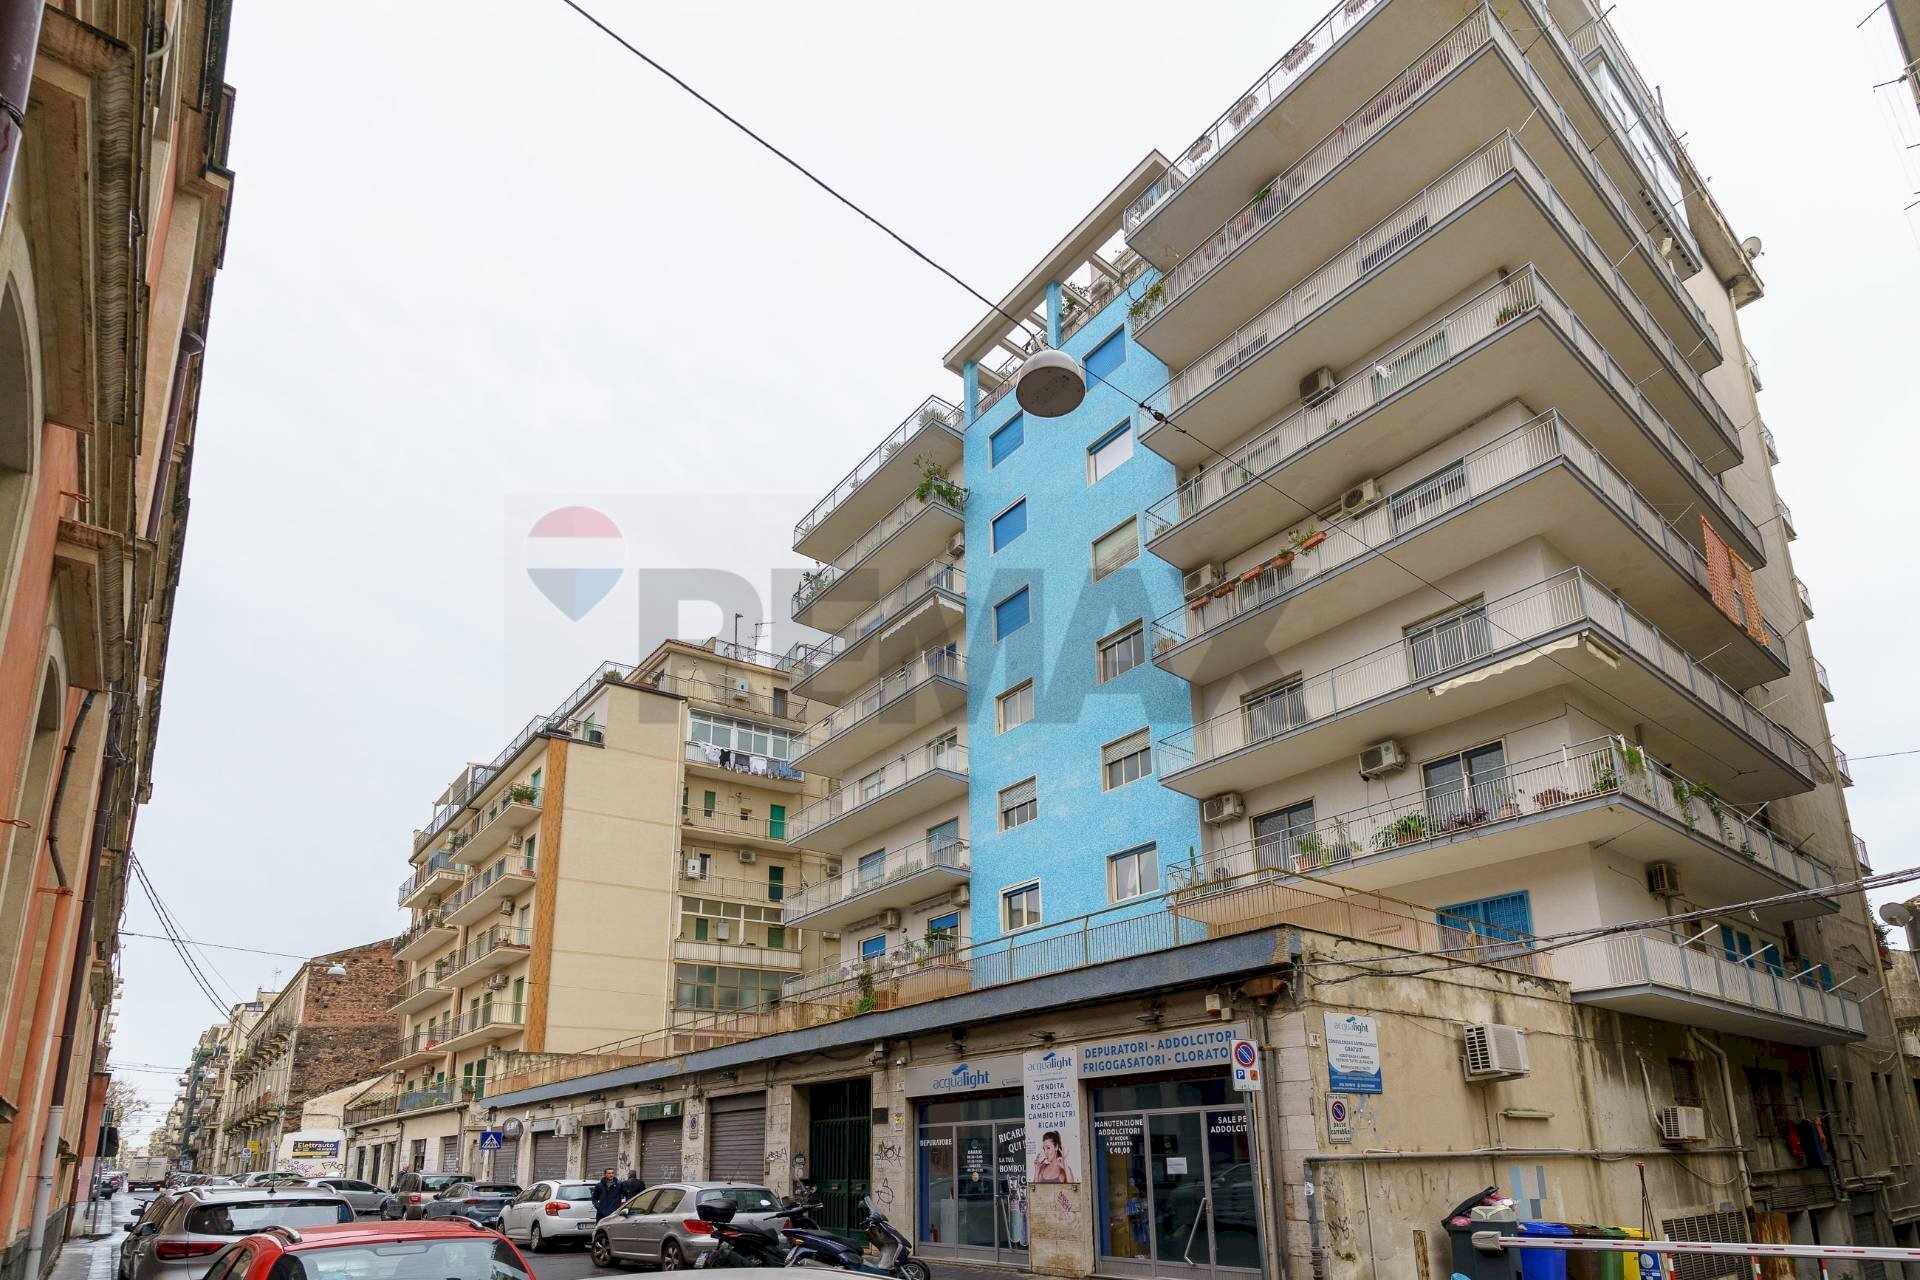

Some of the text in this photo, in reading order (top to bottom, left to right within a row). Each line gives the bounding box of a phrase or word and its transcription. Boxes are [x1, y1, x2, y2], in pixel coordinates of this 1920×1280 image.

[1084, 1041, 1148, 1059] DEPURATORI
[1157, 1029, 1236, 1051] ADDOLCITORI
[1027, 1056, 1072, 1072] acqualight
[1083, 1054, 1165, 1073] FRIGOGASATORI
[1174, 1047, 1230, 1064] CLORATO
[932, 1069, 991, 1091] acqualight
[1036, 1082, 1065, 1091] VENDITA
[1031, 1091, 1071, 1101] ASSISTENZA
[1030, 1102, 1061, 1111] RICARICA
[1028, 1110, 1076, 1120] CAMBIO FILTRI
[1217, 1115, 1247, 1124] SALE PE
[1038, 1120, 1066, 1129] RICAMBI
[1094, 1118, 1144, 1128] MANUTENZIONE
[1098, 1127, 1140, 1136] ADDOLCITORI
[1210, 1124, 1248, 1133] ADDOLCIT
[999, 1164, 1026, 1173] BOMBOL
